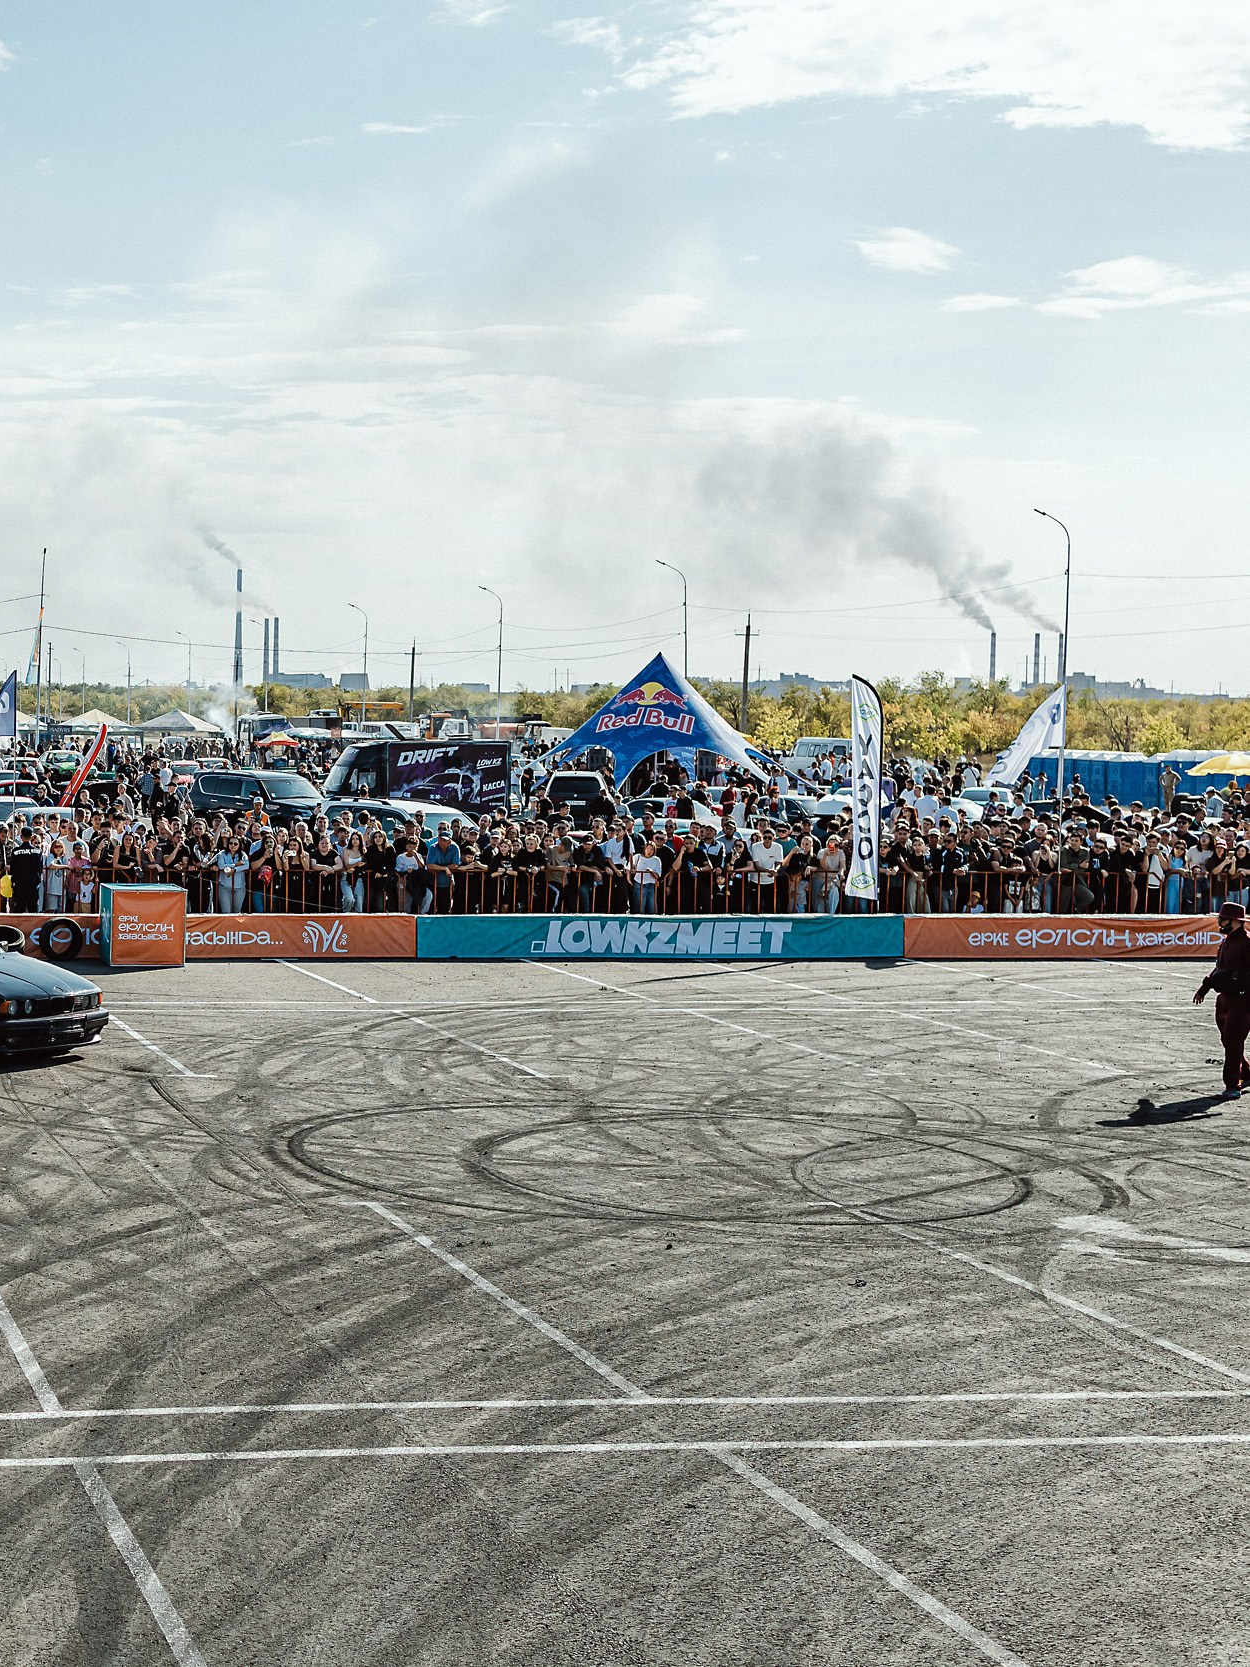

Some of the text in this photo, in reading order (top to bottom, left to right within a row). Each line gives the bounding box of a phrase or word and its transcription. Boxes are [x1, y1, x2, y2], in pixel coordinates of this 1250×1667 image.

[596, 707, 695, 735] Red Bull
[396, 746, 459, 767] DRIFT
[482, 780, 505, 792] КАССА
[545, 920, 792, 954] LOWKZMEET
